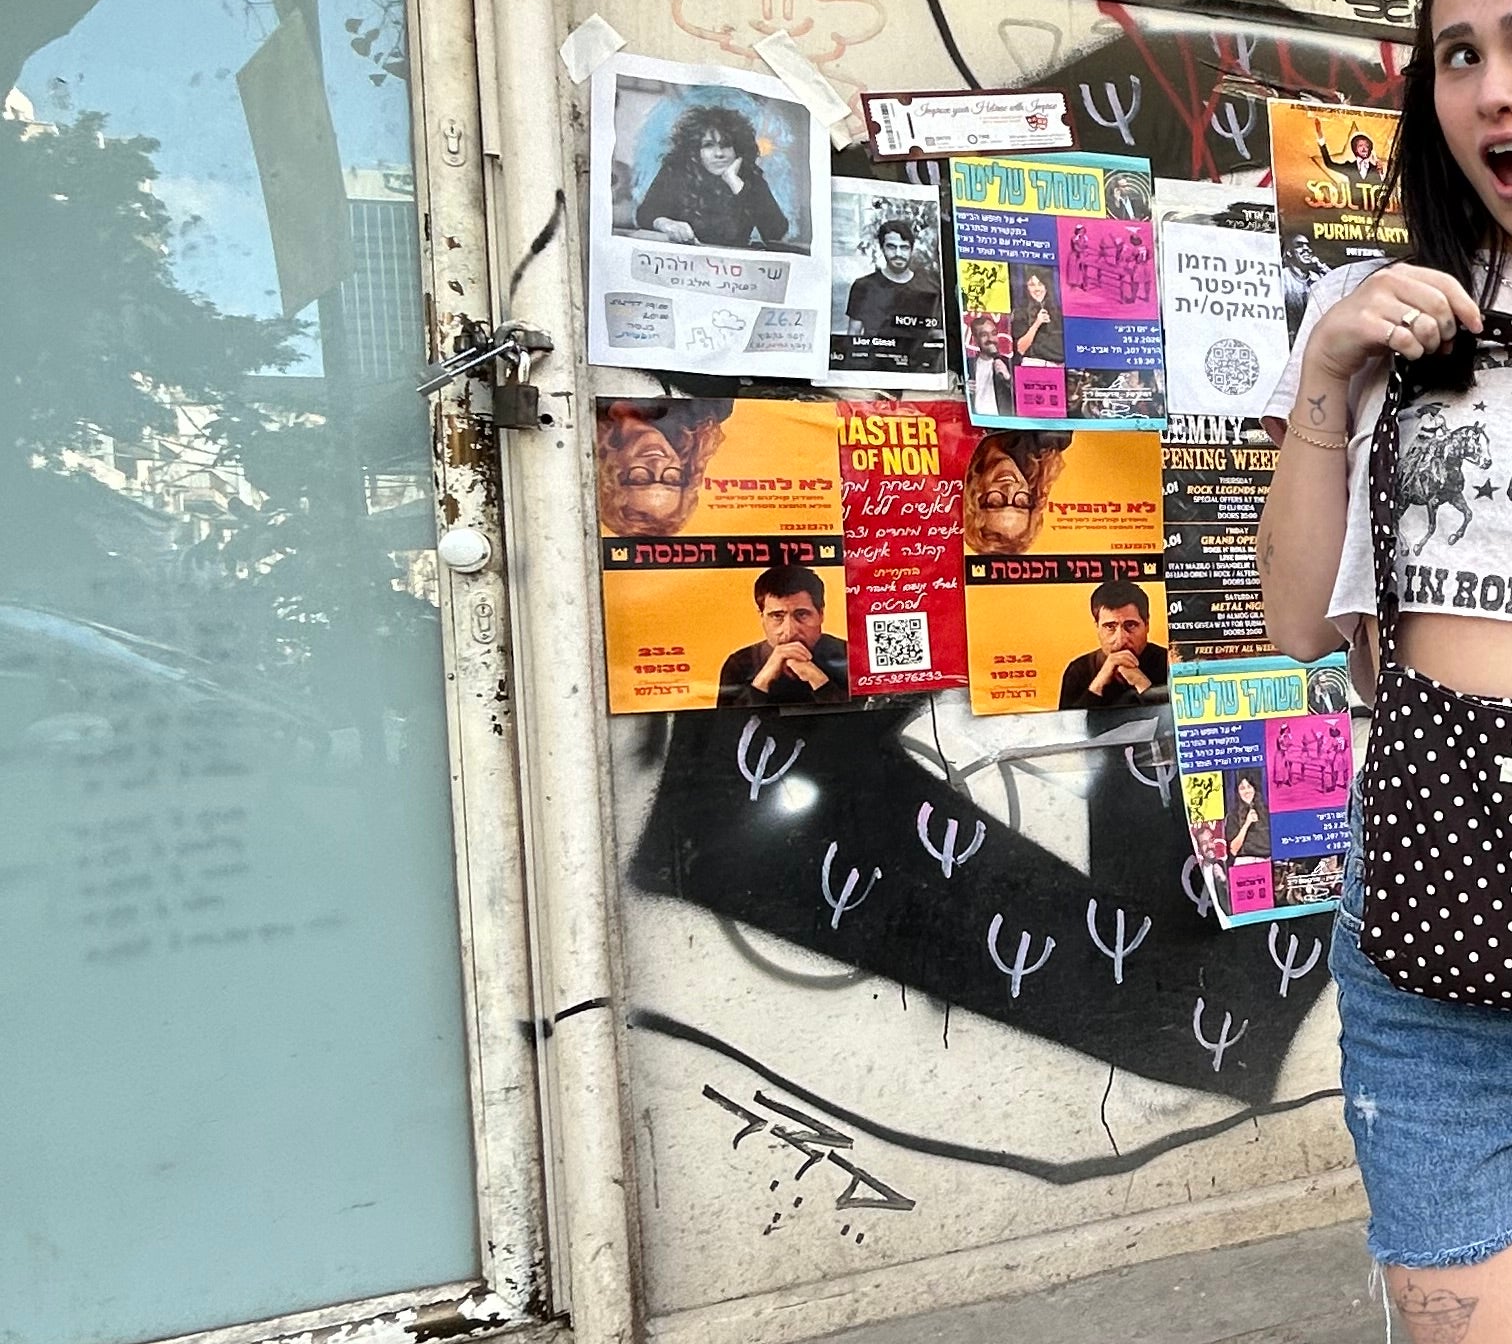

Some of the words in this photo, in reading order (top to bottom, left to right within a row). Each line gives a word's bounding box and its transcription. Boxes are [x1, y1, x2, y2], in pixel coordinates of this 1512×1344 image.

[954, 161, 1026, 205] שליטה
[1029, 169, 1101, 211] משחקי
[1305, 180, 1359, 211] SOUL
[1313, 223, 1363, 240] PURIM
[1364, 225, 1409, 244] PARTY
[1178, 253, 1227, 273] הזמן
[1235, 258, 1281, 276] הגיע
[1190, 276, 1271, 298] להיפטר
[1175, 295, 1285, 322] מהאקס/ית
[764, 310, 804, 328] 26.2
[895, 316, 917, 326] NOV
[925, 319, 938, 327] 20
[852, 449, 879, 470] OF
[882, 447, 940, 475] NON
[1162, 448, 1227, 470] PENING
[799, 478, 833, 490] לא
[877, 478, 926, 502] משחק
[1187, 485, 1213, 494] ROCK
[1215, 485, 1256, 495] LEGENDS
[862, 495, 900, 515] ללא
[901, 495, 961, 520] לאנשים
[1127, 501, 1156, 513] לא
[1219, 496, 1243, 504] OFFERS
[1200, 535, 1235, 545] GRAND
[634, 543, 716, 564] הכנסת
[726, 542, 770, 562] בתי
[779, 542, 814, 565] בין
[901, 543, 946, 562] קבוצה
[990, 561, 1059, 579] הכנסת
[1066, 560, 1103, 578] בתי
[1110, 560, 1139, 581] בין
[871, 592, 928, 612] לפרטים
[1211, 602, 1243, 611] METAL
[1225, 593, 1258, 601] SATURDAY
[1168, 600, 1183, 615] .01
[1223, 628, 1245, 636] DOORS
[638, 646, 685, 657] 23.2
[993, 654, 1033, 664] 23.2
[1195, 645, 1214, 655] FREE
[1215, 645, 1239, 654] ENTRY
[633, 663, 690, 674] 19:30
[990, 670, 1037, 679] 19:30
[1175, 677, 1239, 719] שליטה
[1241, 675, 1304, 718] משחקי
